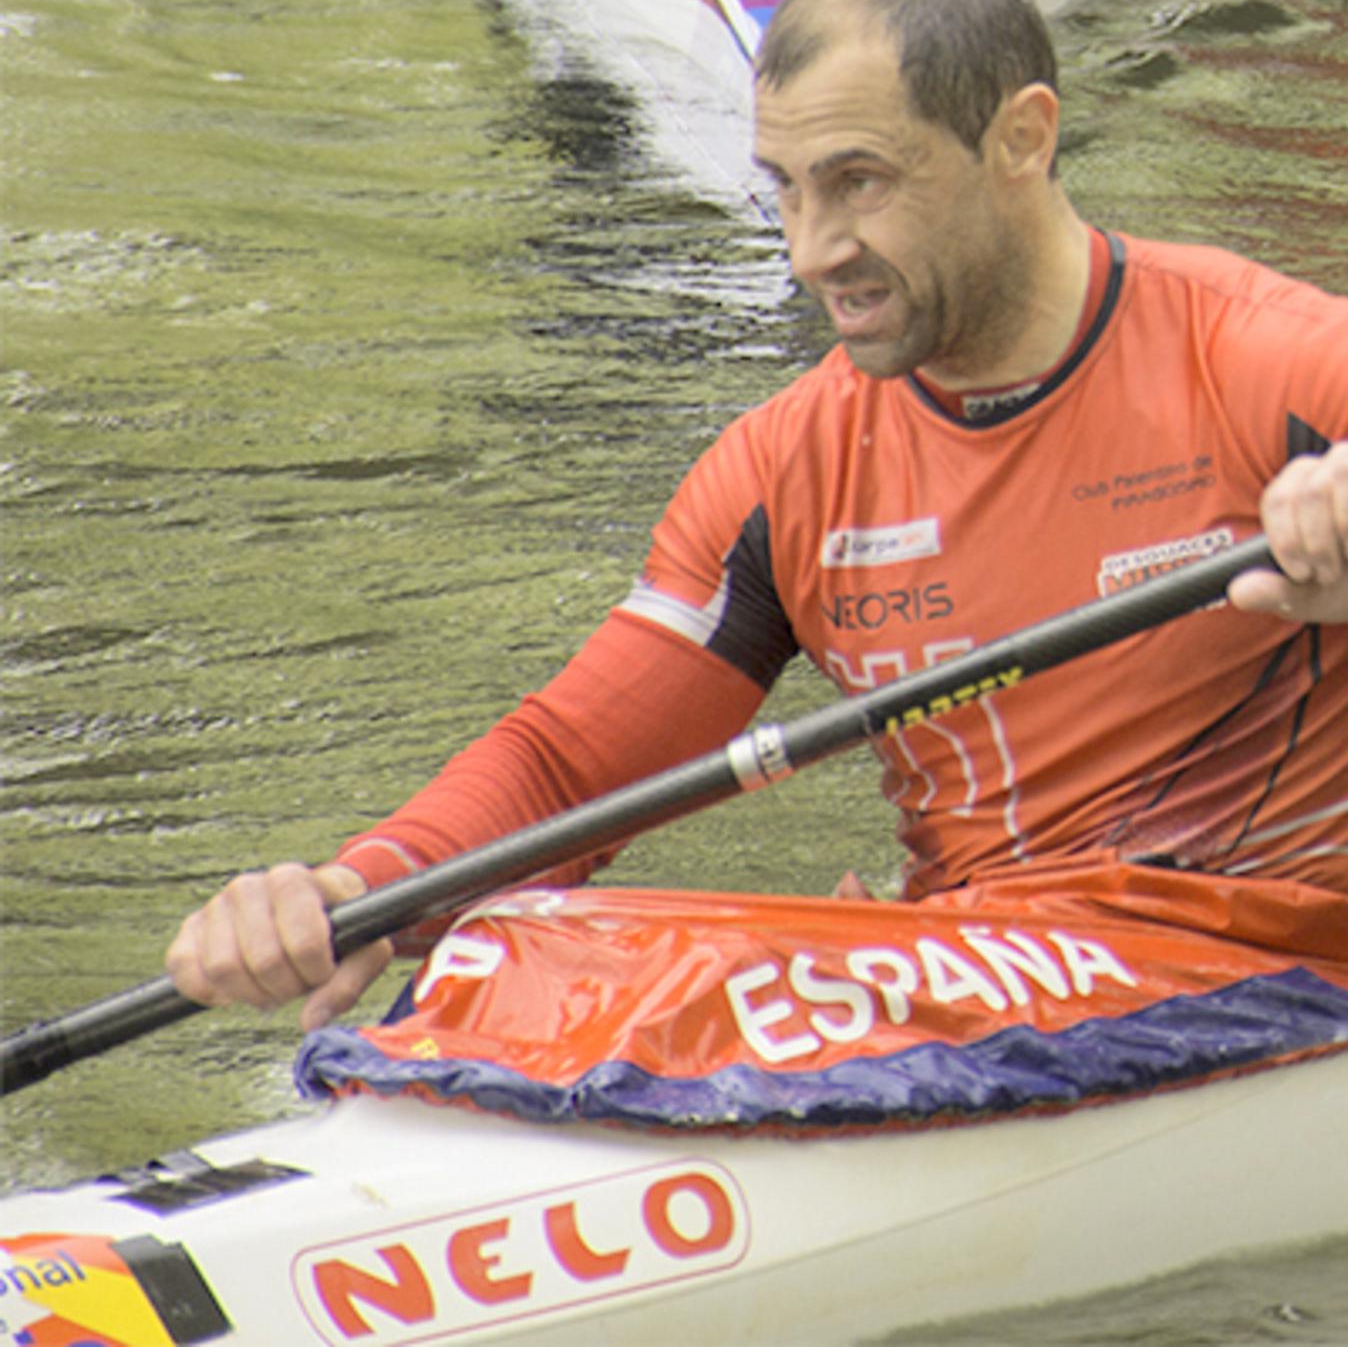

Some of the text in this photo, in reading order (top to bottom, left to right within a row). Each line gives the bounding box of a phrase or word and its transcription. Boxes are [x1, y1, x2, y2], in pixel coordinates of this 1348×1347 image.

[819, 581, 955, 630] NEORIS
[725, 925, 1138, 1063] ESPAÑA
[312, 1172, 734, 1339] NELO
